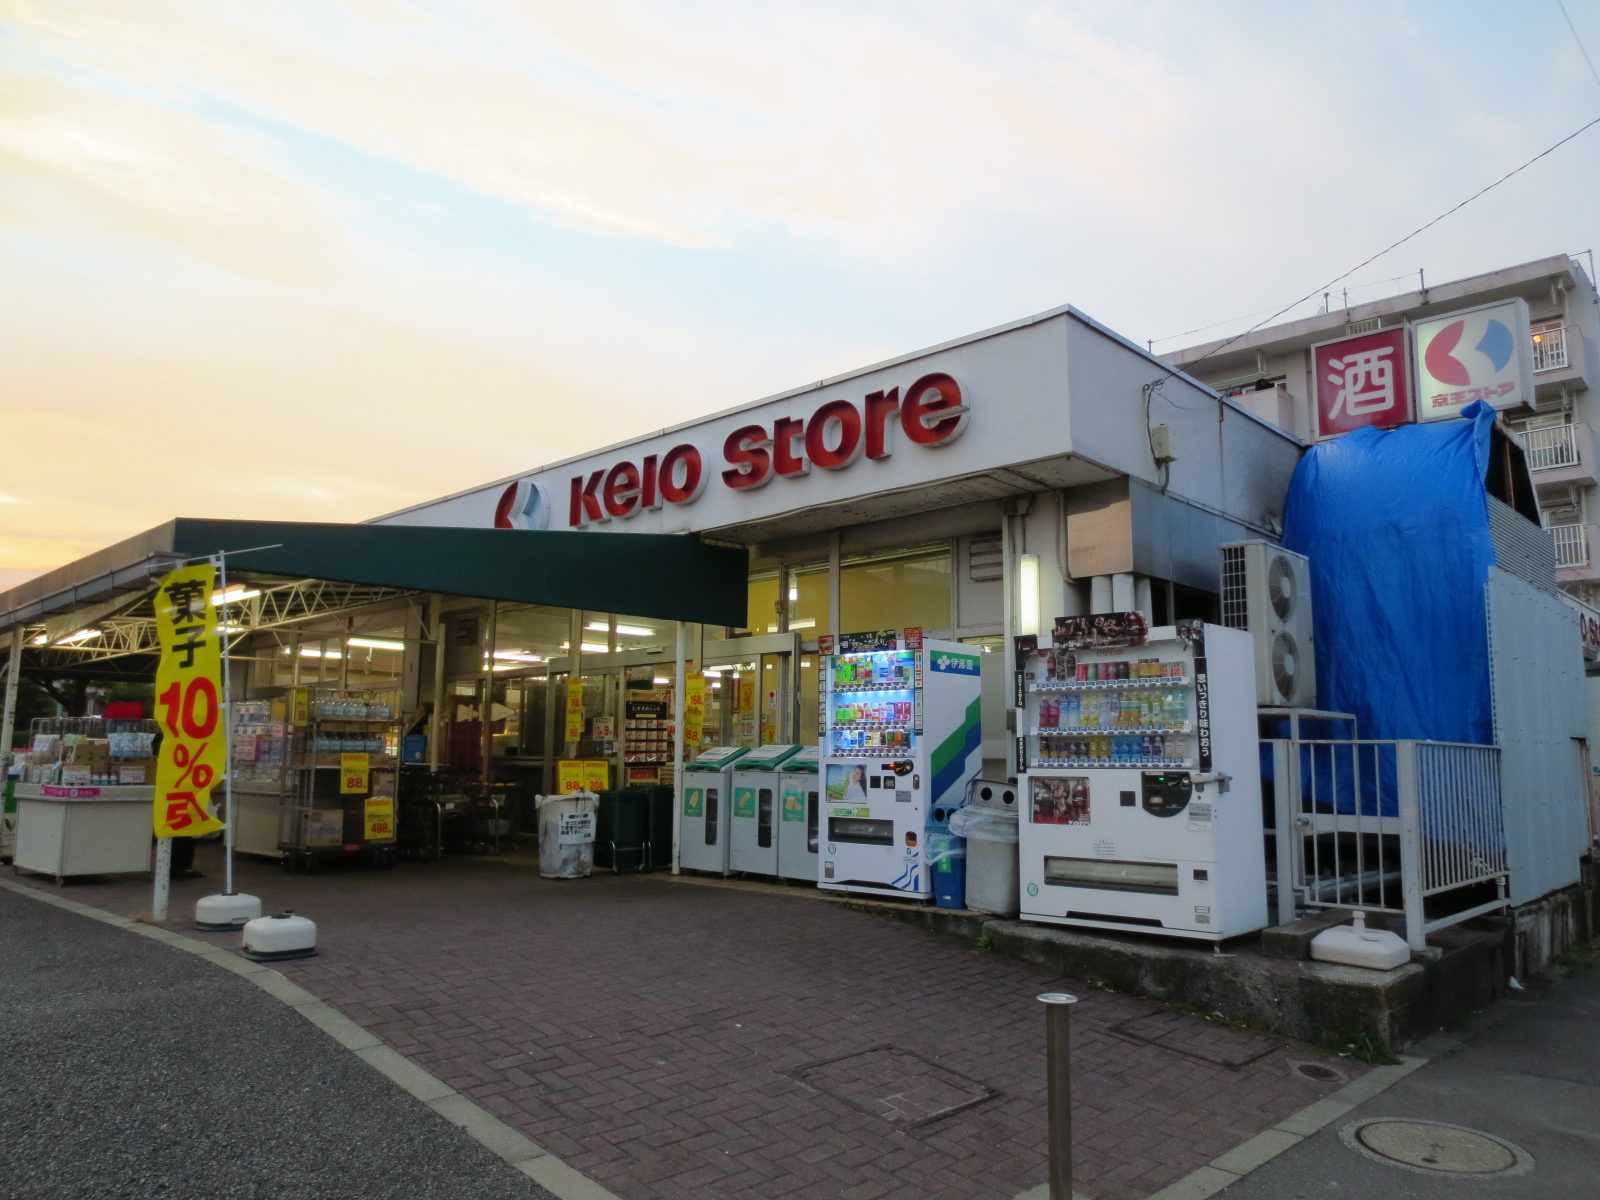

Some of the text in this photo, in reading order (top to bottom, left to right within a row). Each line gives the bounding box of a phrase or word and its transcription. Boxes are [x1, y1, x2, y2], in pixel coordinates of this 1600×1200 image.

[1326, 345, 1395, 420] 酒
[1430, 381, 1515, 409] 京王ストア
[950, 657, 974, 671] 伊藤園
[1197, 673, 1209, 757] 思いっきり味わおう
